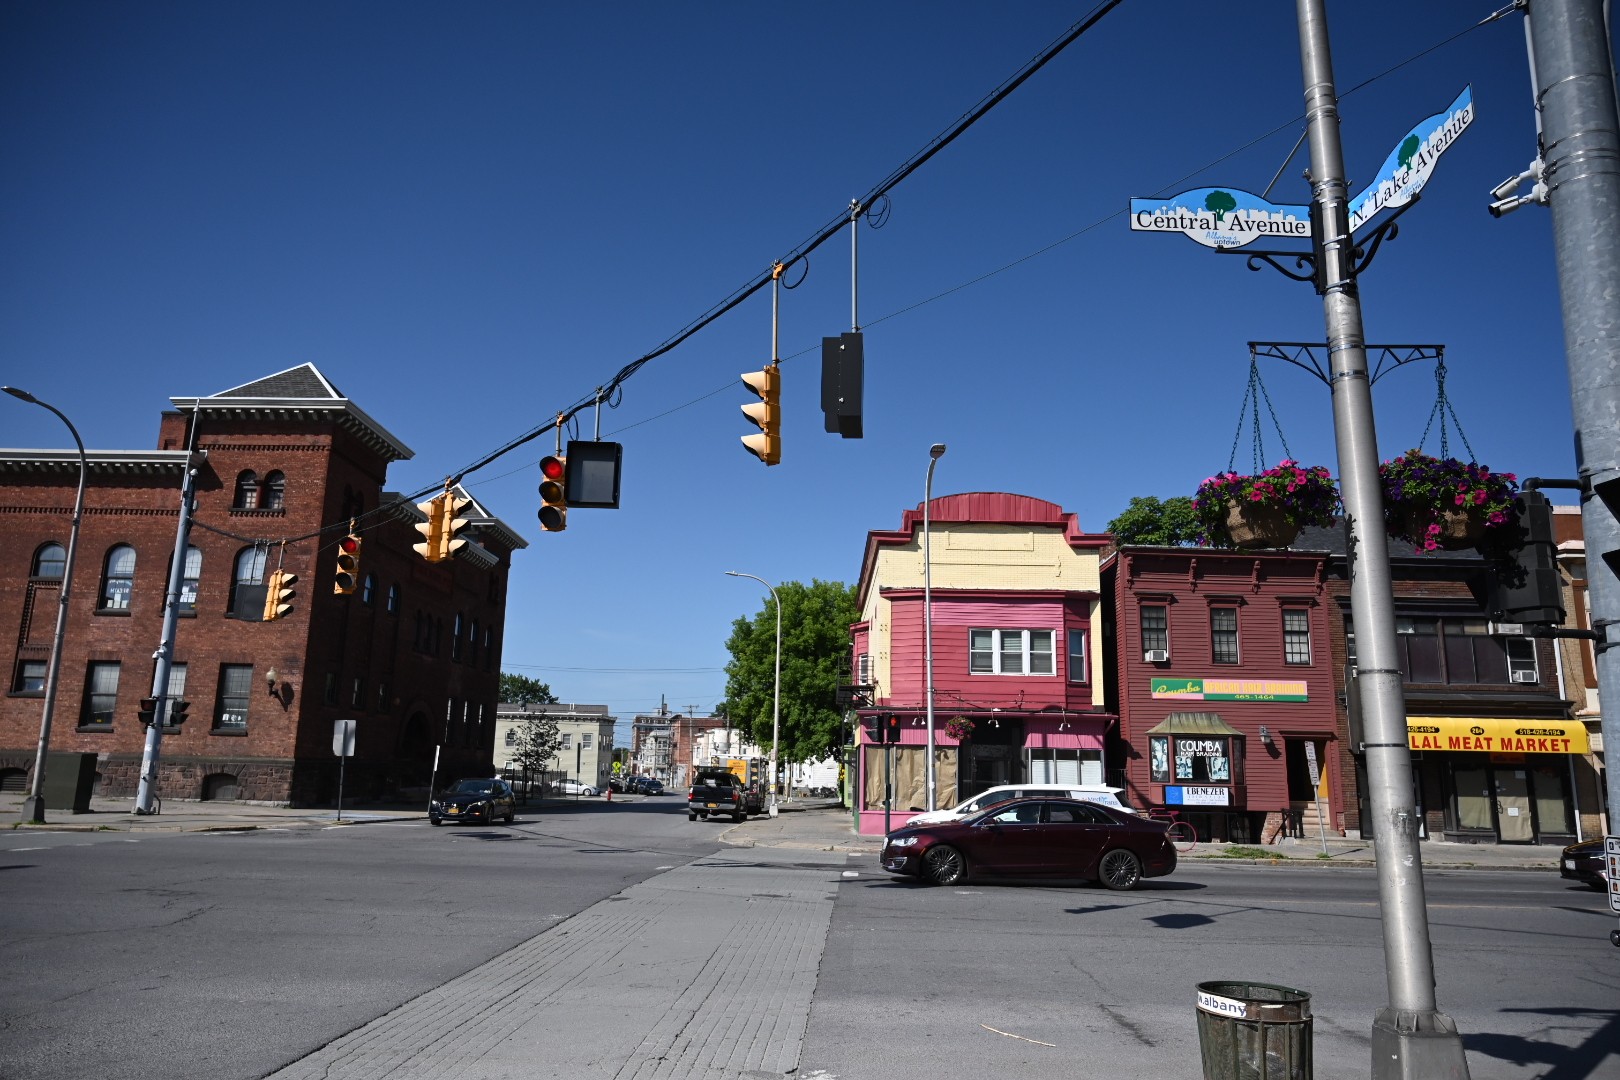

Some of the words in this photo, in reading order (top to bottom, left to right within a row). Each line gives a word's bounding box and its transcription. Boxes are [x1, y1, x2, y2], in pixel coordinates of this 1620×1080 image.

[1352, 204, 1368, 229] N.
[1373, 171, 1410, 212] Lake
[1415, 109, 1470, 174] Avenue
[1137, 210, 1219, 231] Central
[1229, 213, 1306, 234] Avenue
[1156, 682, 1201, 697] Coumba
[1205, 681, 1240, 694] AFRICAN
[1242, 682, 1262, 695] HAIR
[1265, 682, 1305, 695] BRAIDING
[1181, 740, 1222, 752] COUMBA
[1448, 736, 1493, 750] MEAT
[1500, 738, 1571, 752] MARKET
[1186, 787, 1225, 796] EBENEZER
